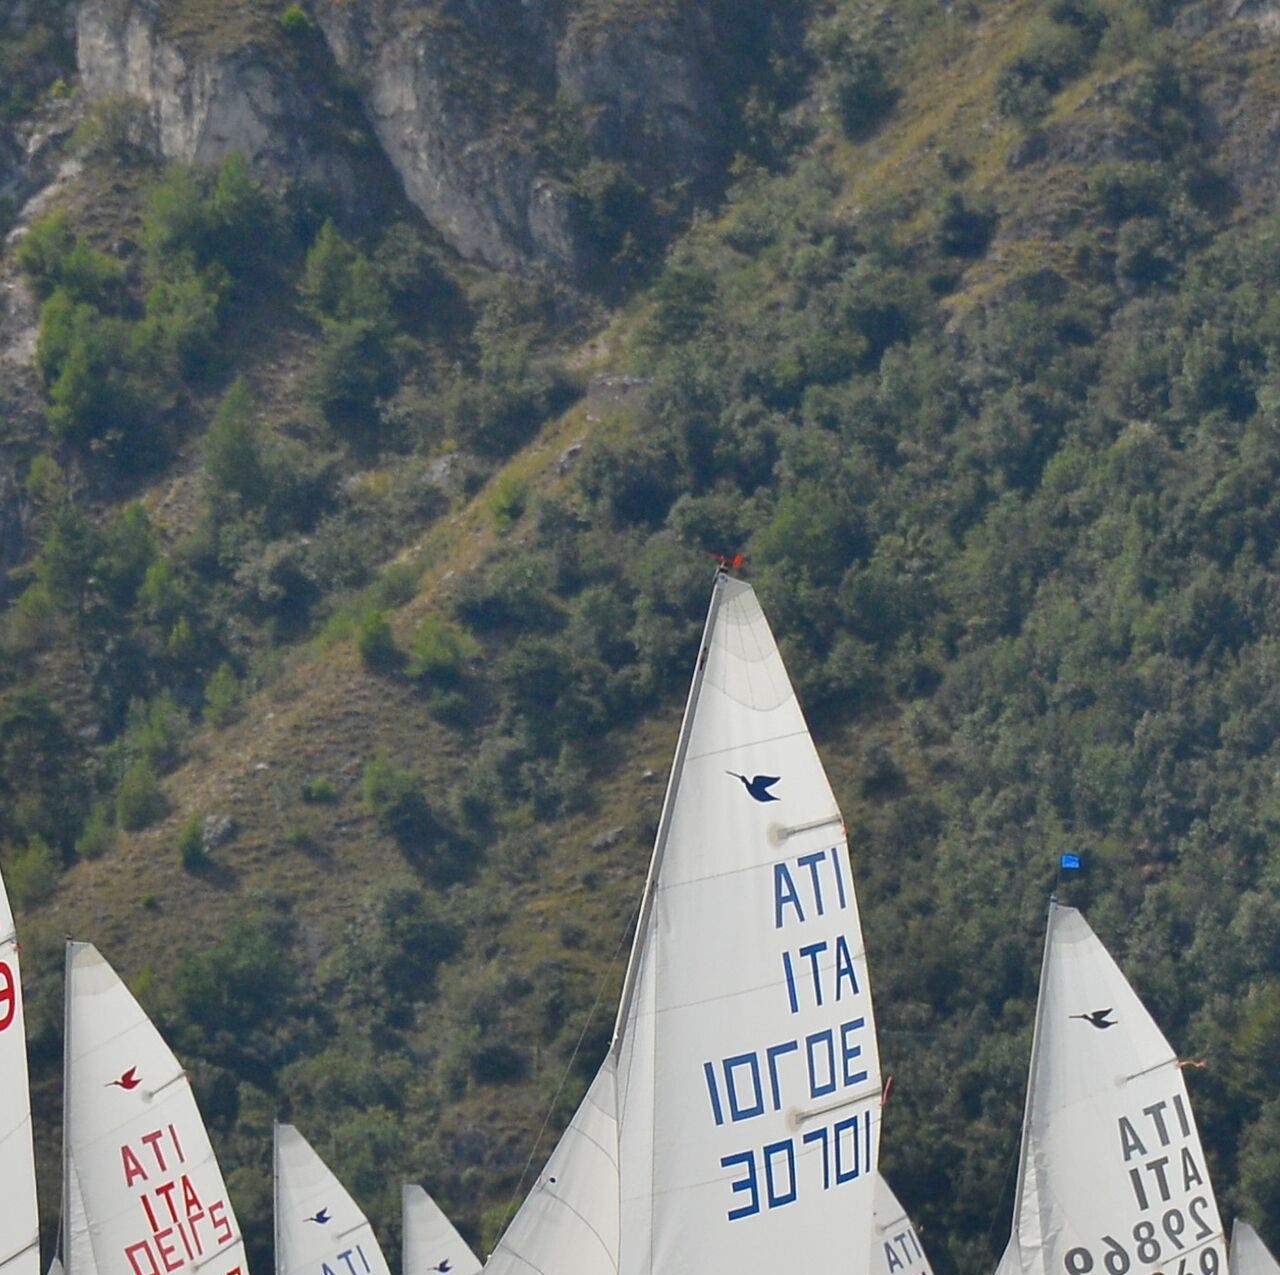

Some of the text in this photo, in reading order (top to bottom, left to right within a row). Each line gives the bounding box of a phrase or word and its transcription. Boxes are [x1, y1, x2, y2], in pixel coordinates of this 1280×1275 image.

[783, 935, 859, 1013] ITA
[720, 1110, 871, 1221] 30701
[1128, 1147, 1203, 1211] ITA
[140, 1175, 204, 1232] ITA
